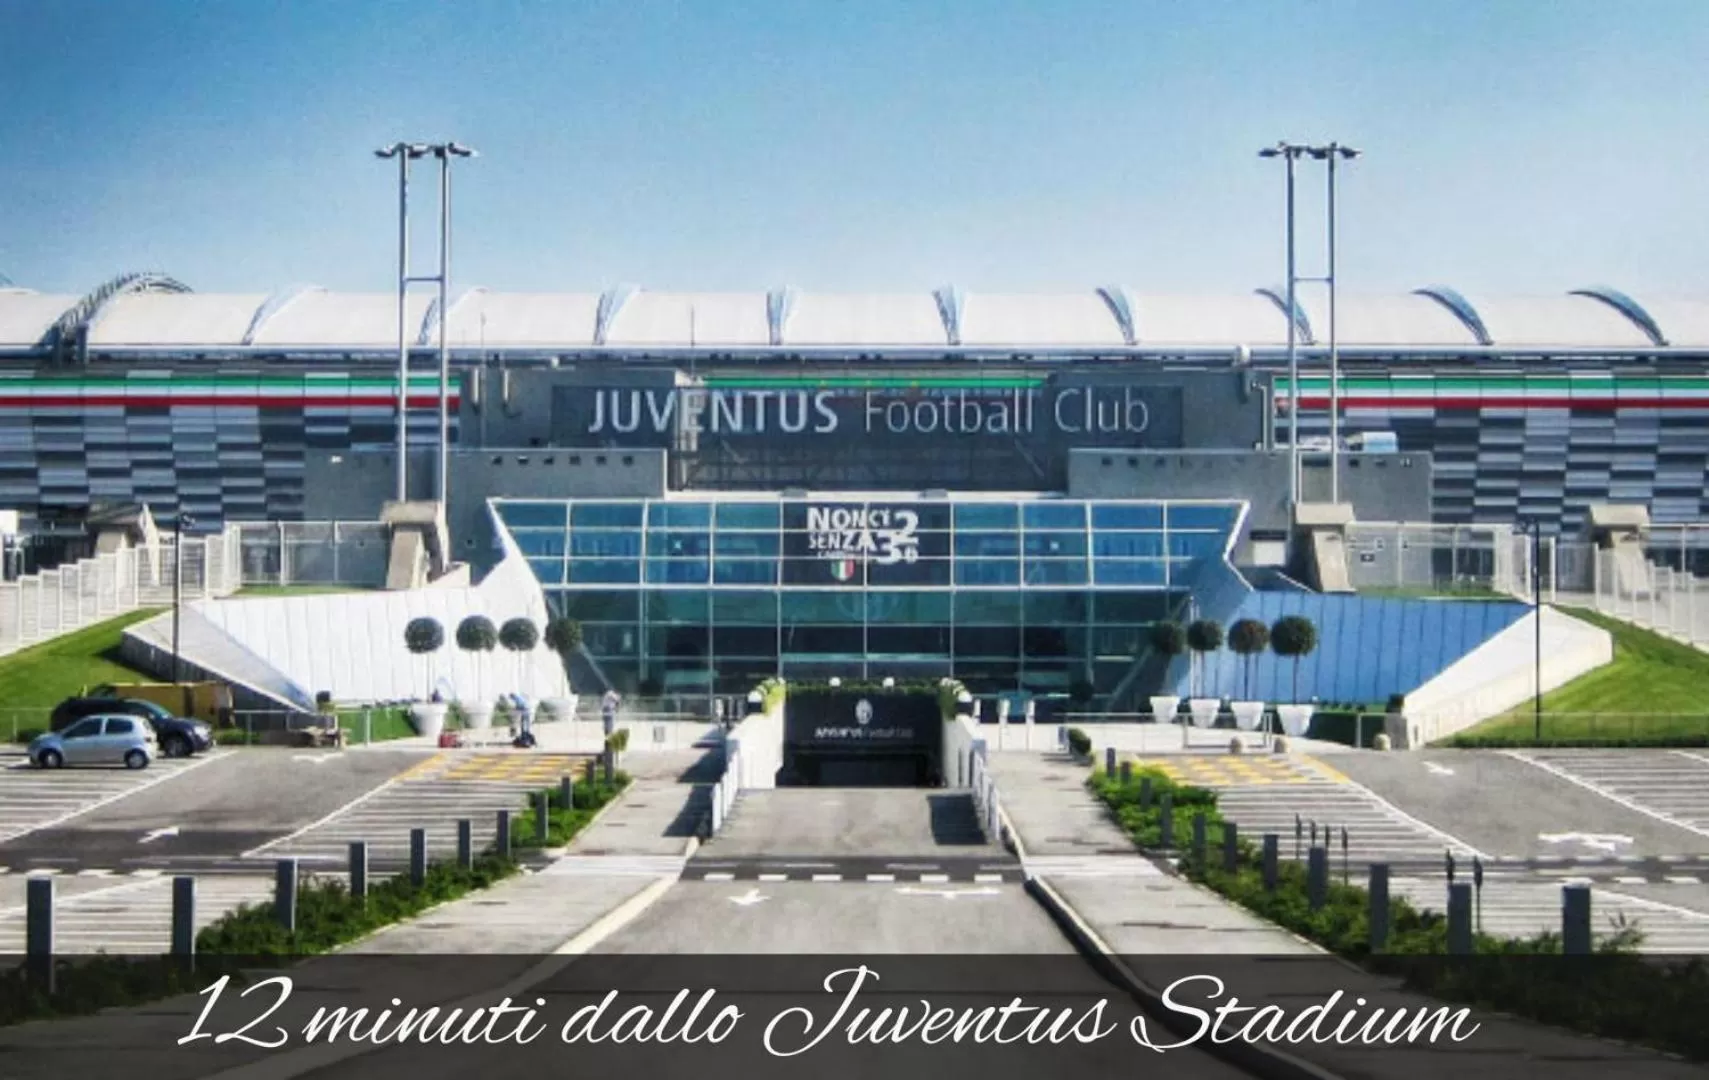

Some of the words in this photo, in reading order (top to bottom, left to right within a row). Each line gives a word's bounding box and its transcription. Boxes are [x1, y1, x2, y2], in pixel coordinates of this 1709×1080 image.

[588, 389, 838, 433] JUVENTUS
[864, 386, 1034, 433] Football
[1053, 386, 1149, 433] Club
[808, 530, 878, 552] SENZA
